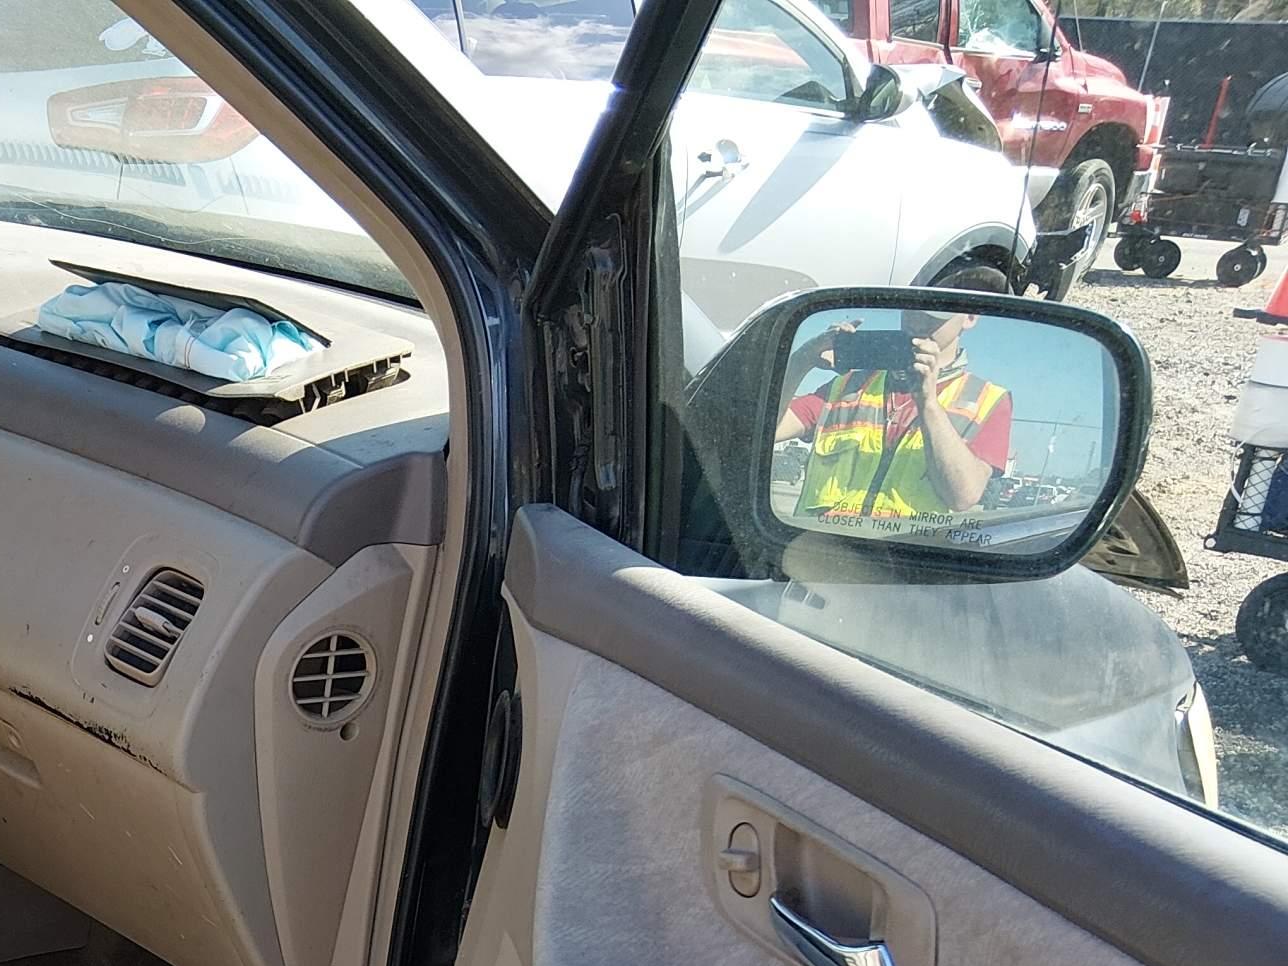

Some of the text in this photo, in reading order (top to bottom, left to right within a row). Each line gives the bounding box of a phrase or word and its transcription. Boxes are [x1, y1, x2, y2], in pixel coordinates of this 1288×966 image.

[817, 514, 992, 545] CLOSER THAN THEY APPEAR
[890, 508, 902, 519] IN
[909, 511, 953, 526] MIRROR
[960, 518, 983, 530] ARE
